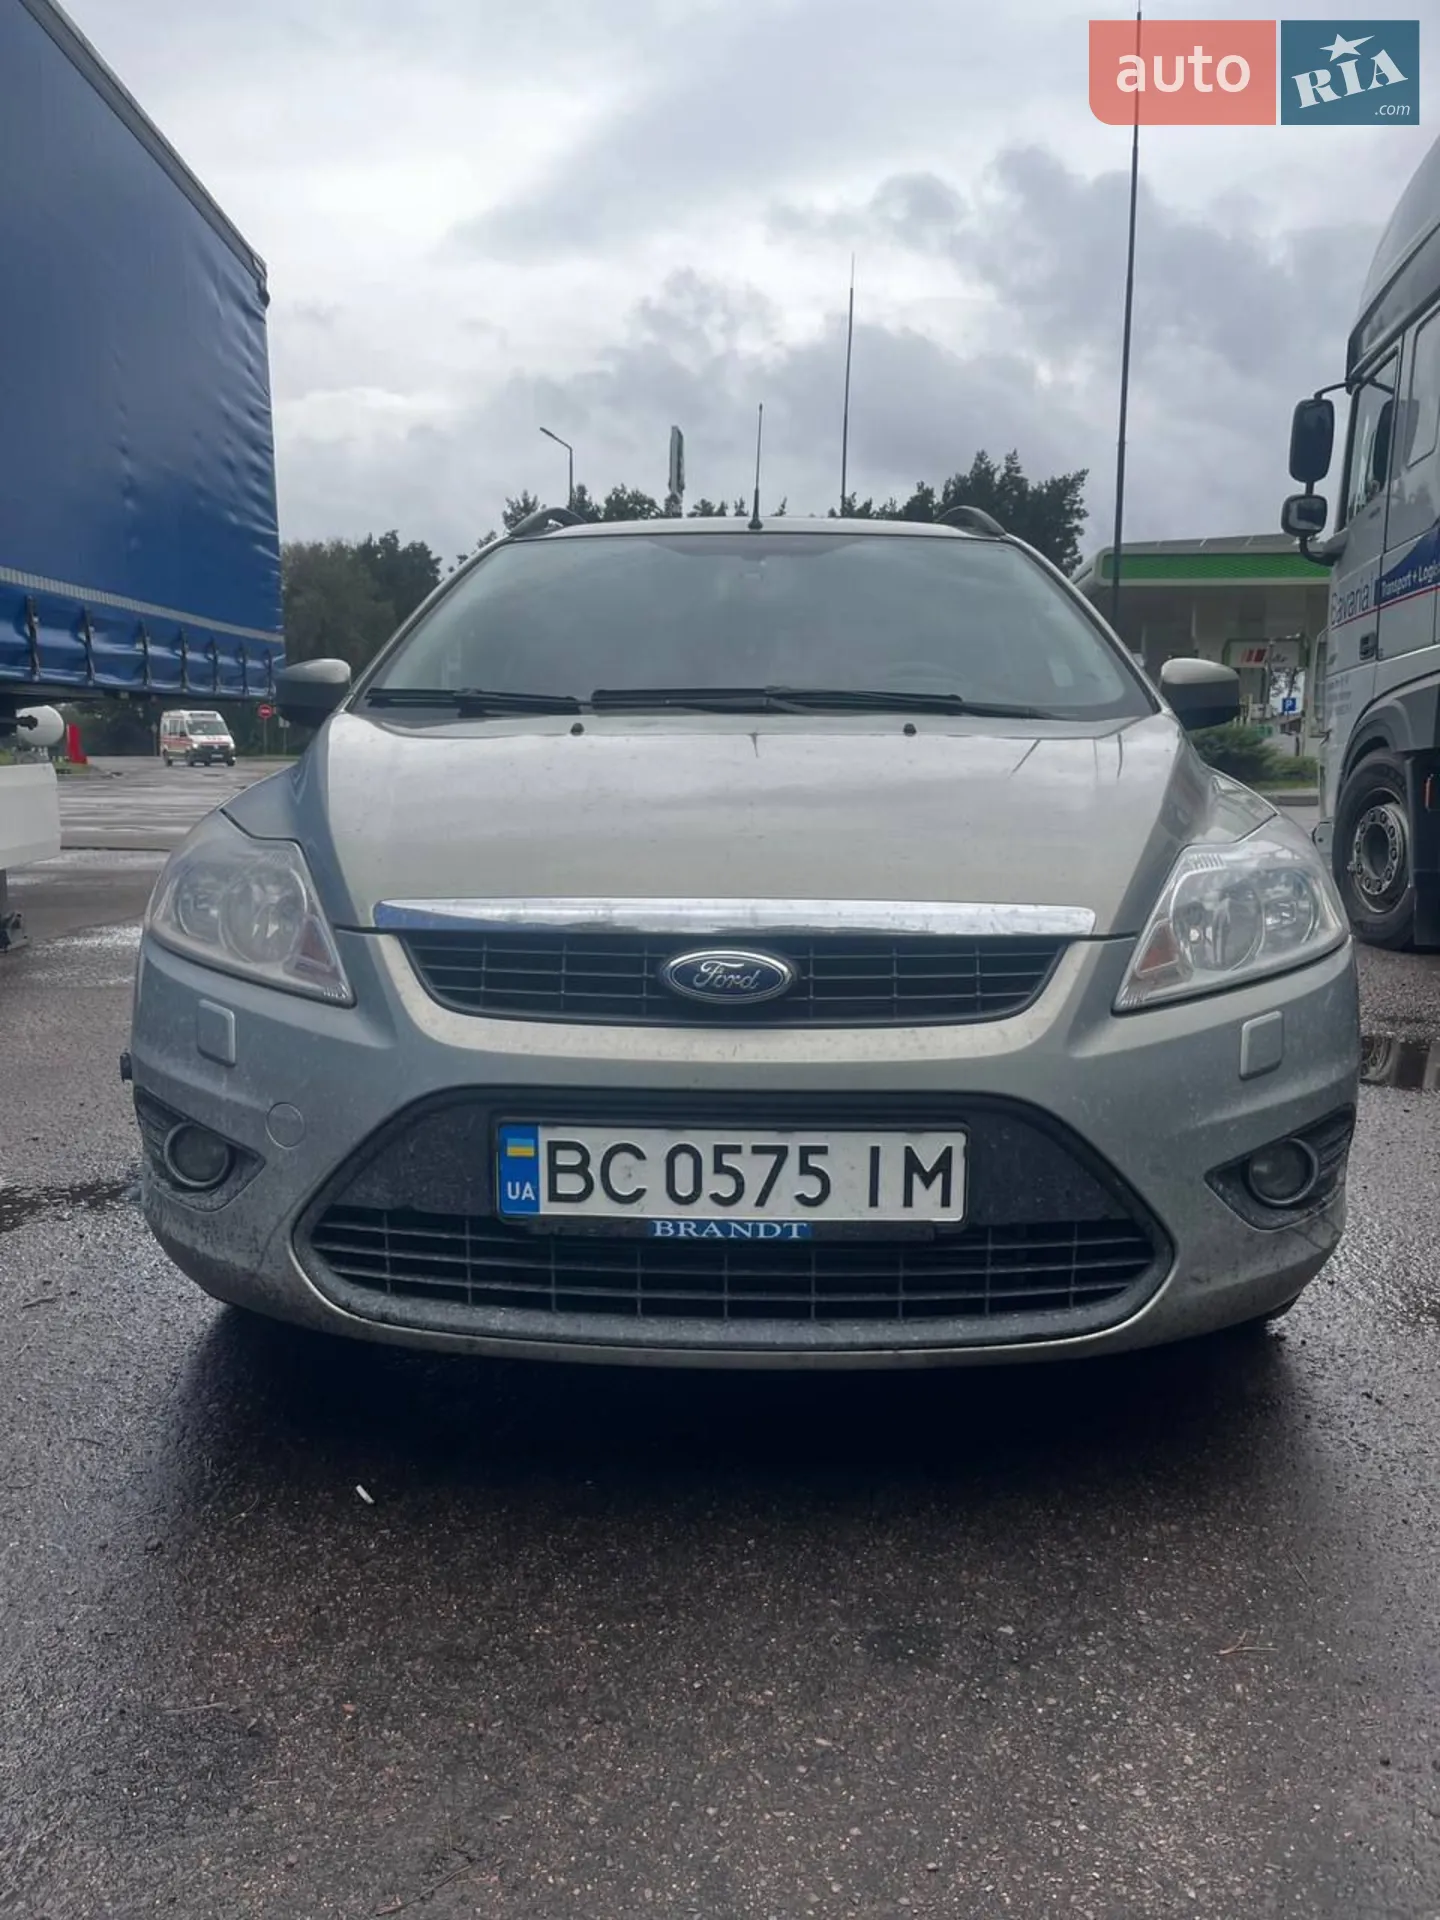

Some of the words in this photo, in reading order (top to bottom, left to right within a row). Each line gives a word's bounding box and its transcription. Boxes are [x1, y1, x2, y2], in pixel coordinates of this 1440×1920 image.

[693, 960, 761, 989] Ford
[547, 1140, 648, 1205] BC
[665, 1143, 831, 1208] 0575
[868, 1145, 953, 1208] IM
[507, 1181, 535, 1200] UA
[653, 1220, 807, 1240] BRANDT
